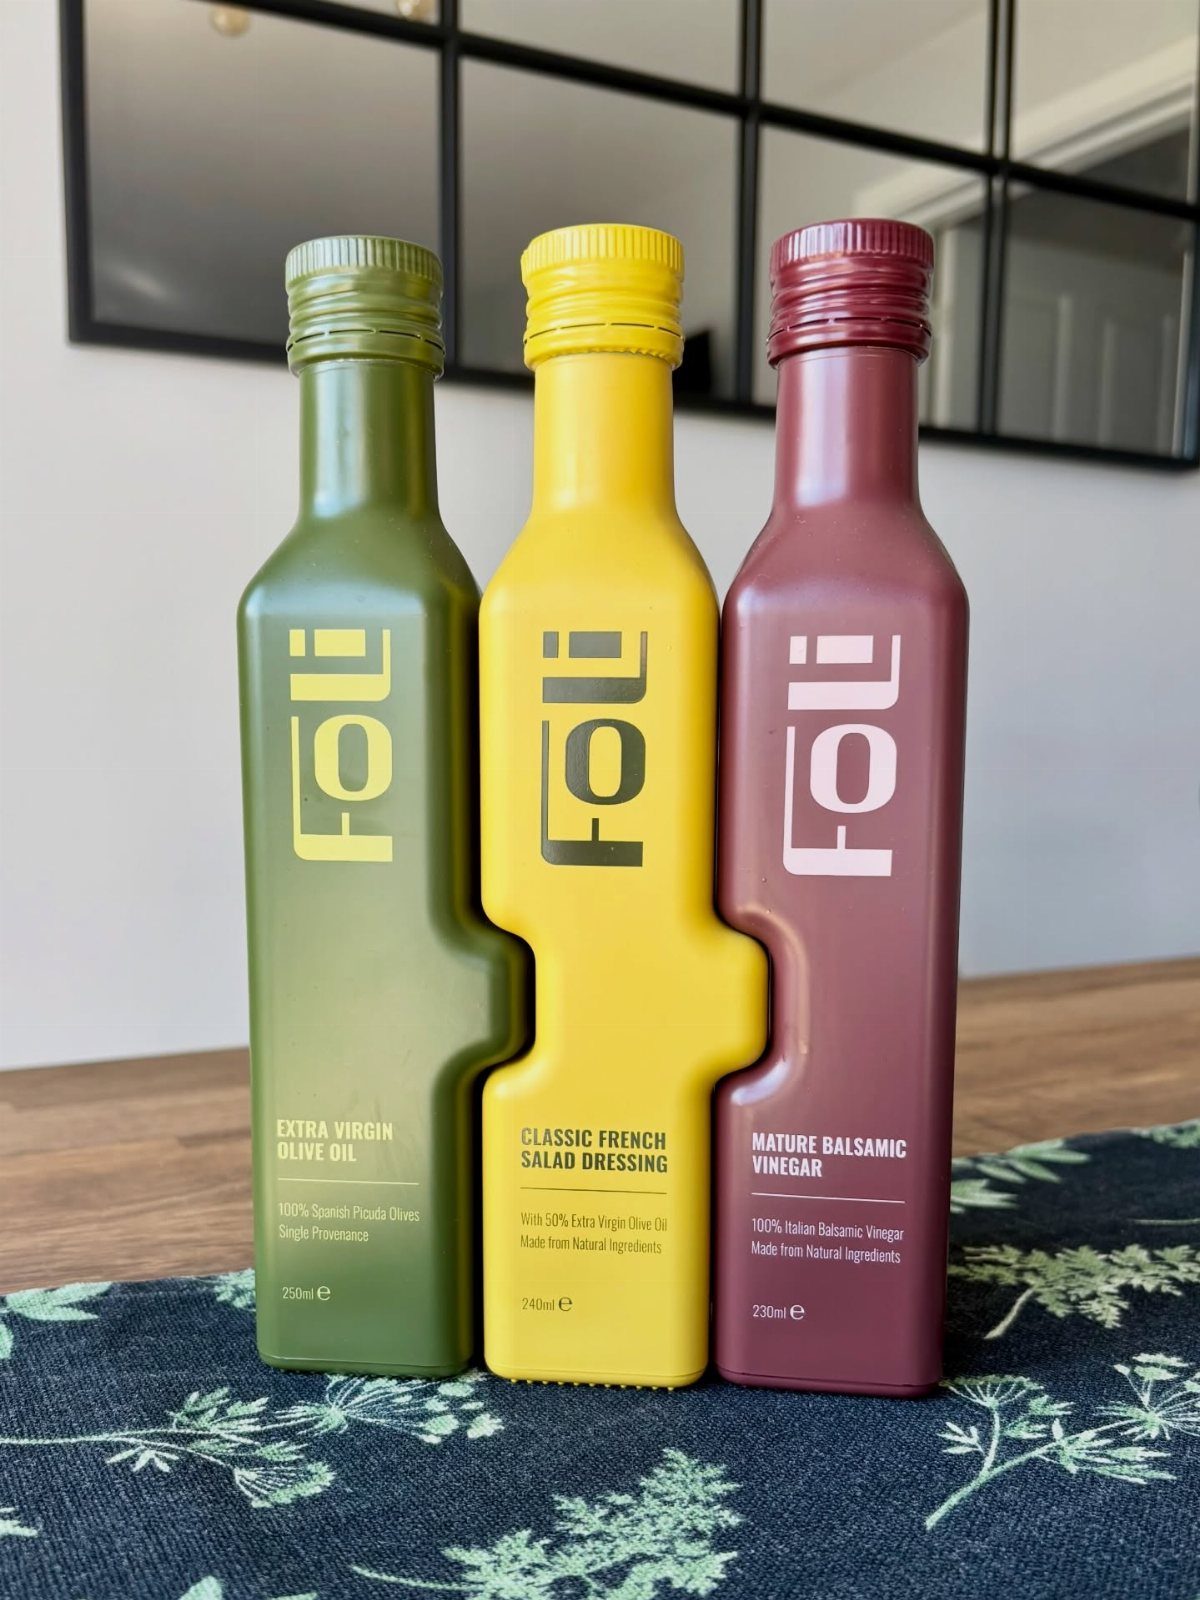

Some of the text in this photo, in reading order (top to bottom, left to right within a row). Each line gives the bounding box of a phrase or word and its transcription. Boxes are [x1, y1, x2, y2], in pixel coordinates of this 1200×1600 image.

[277, 1119, 392, 1140] EXTRA VIRGIN
[521, 1128, 665, 1150] CLASSIC FRENCH
[278, 1142, 356, 1161] OLIVE OIL
[753, 1132, 907, 1158] MATURE BALSAMIC
[521, 1151, 667, 1173] SALAD DRESSING
[753, 1156, 822, 1177] VINEGAR
[279, 1203, 420, 1221] 100% Spanish Picuda Olives
[521, 1212, 667, 1231] With 50% Extra Virgin Olive Oil
[279, 1225, 368, 1241] Single Provenance
[752, 1218, 904, 1242] 100% Italian Balsamic Vinegar
[521, 1235, 661, 1254] Made from Natural Ingredients
[752, 1241, 900, 1263] Made from Natural Ingredients
[283, 1287, 313, 1300] 250ml
[522, 1298, 554, 1310] 240ml
[753, 1305, 786, 1319] 230ml
